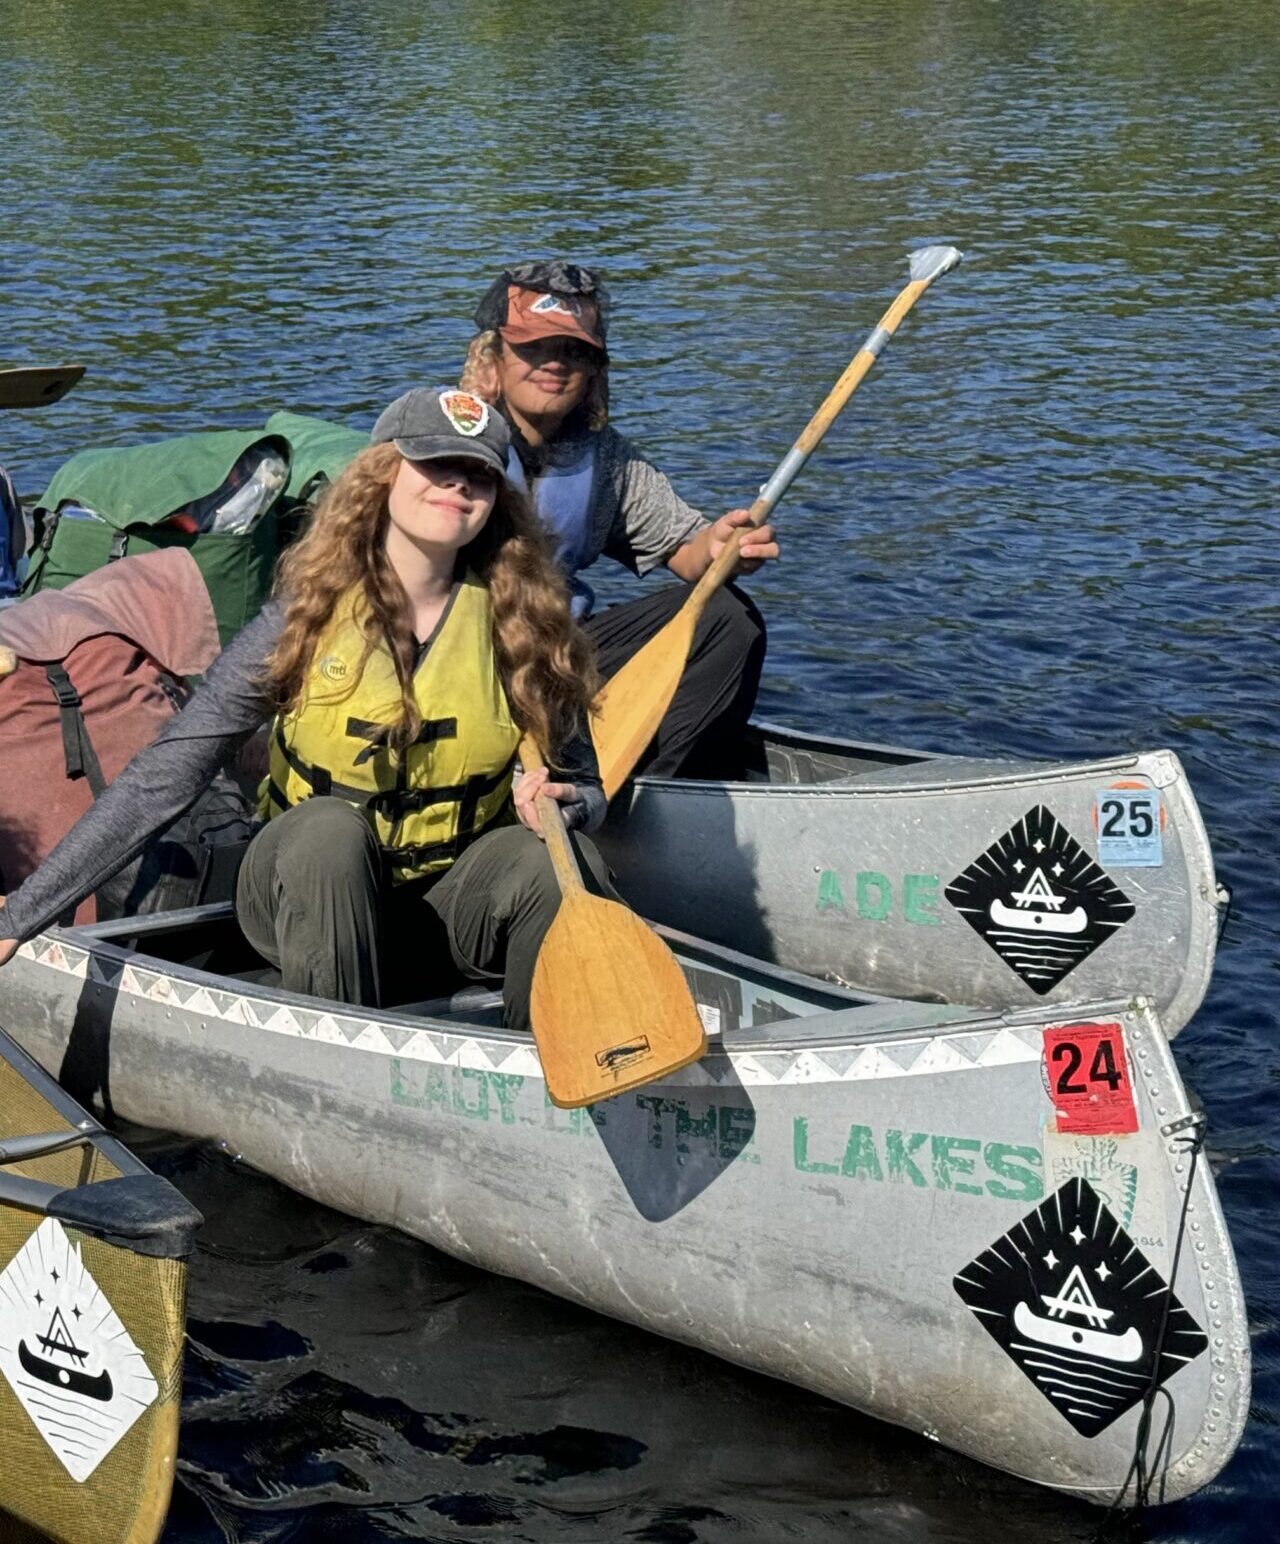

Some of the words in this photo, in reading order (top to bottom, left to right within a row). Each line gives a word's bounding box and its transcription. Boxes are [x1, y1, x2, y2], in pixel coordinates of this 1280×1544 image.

[1101, 800, 1153, 837] 25
[817, 870, 943, 926] ADE
[1052, 1040, 1122, 1095] 24
[793, 1114, 1045, 1202] LAKES
